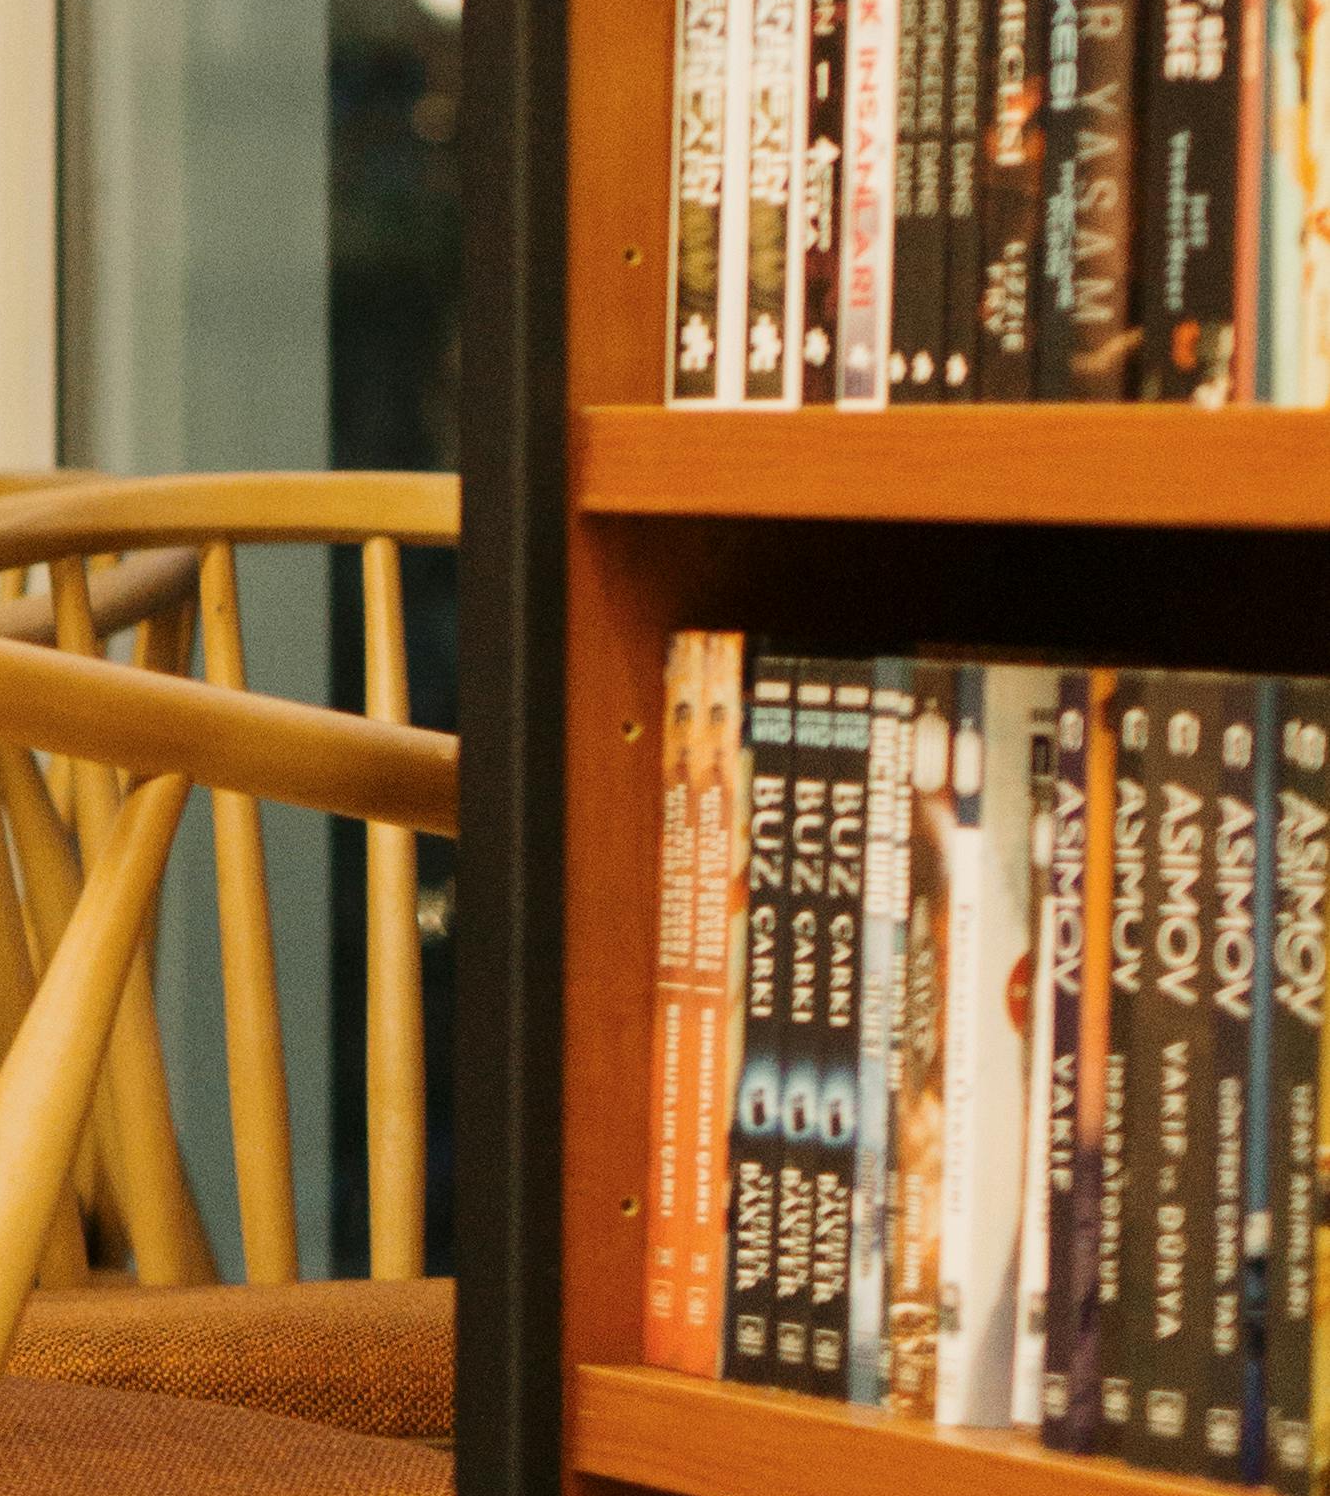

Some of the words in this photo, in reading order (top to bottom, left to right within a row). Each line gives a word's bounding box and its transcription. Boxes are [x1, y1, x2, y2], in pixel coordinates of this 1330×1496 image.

[750, 776, 786, 891] BUZ
[791, 780, 826, 895] BUZ
[828, 783, 863, 899] BUZ
[1053, 781, 1087, 995] ASIMOV
[1156, 783, 1203, 1005] ASIMOV
[750, 906, 775, 1018] ÇARKI
[790, 910, 817, 1024] ÇARKI
[1212, 797, 1257, 1021] ASIMOV
[827, 913, 854, 1028] ÇARKI
[1160, 1041, 1189, 1158] VAKIF
[736, 1163, 762, 1291] BAXTER
[776, 1168, 802, 1299] BAXTER
[812, 1174, 837, 1305] BAXTER
[1154, 1206, 1188, 1341] DÜNYA
